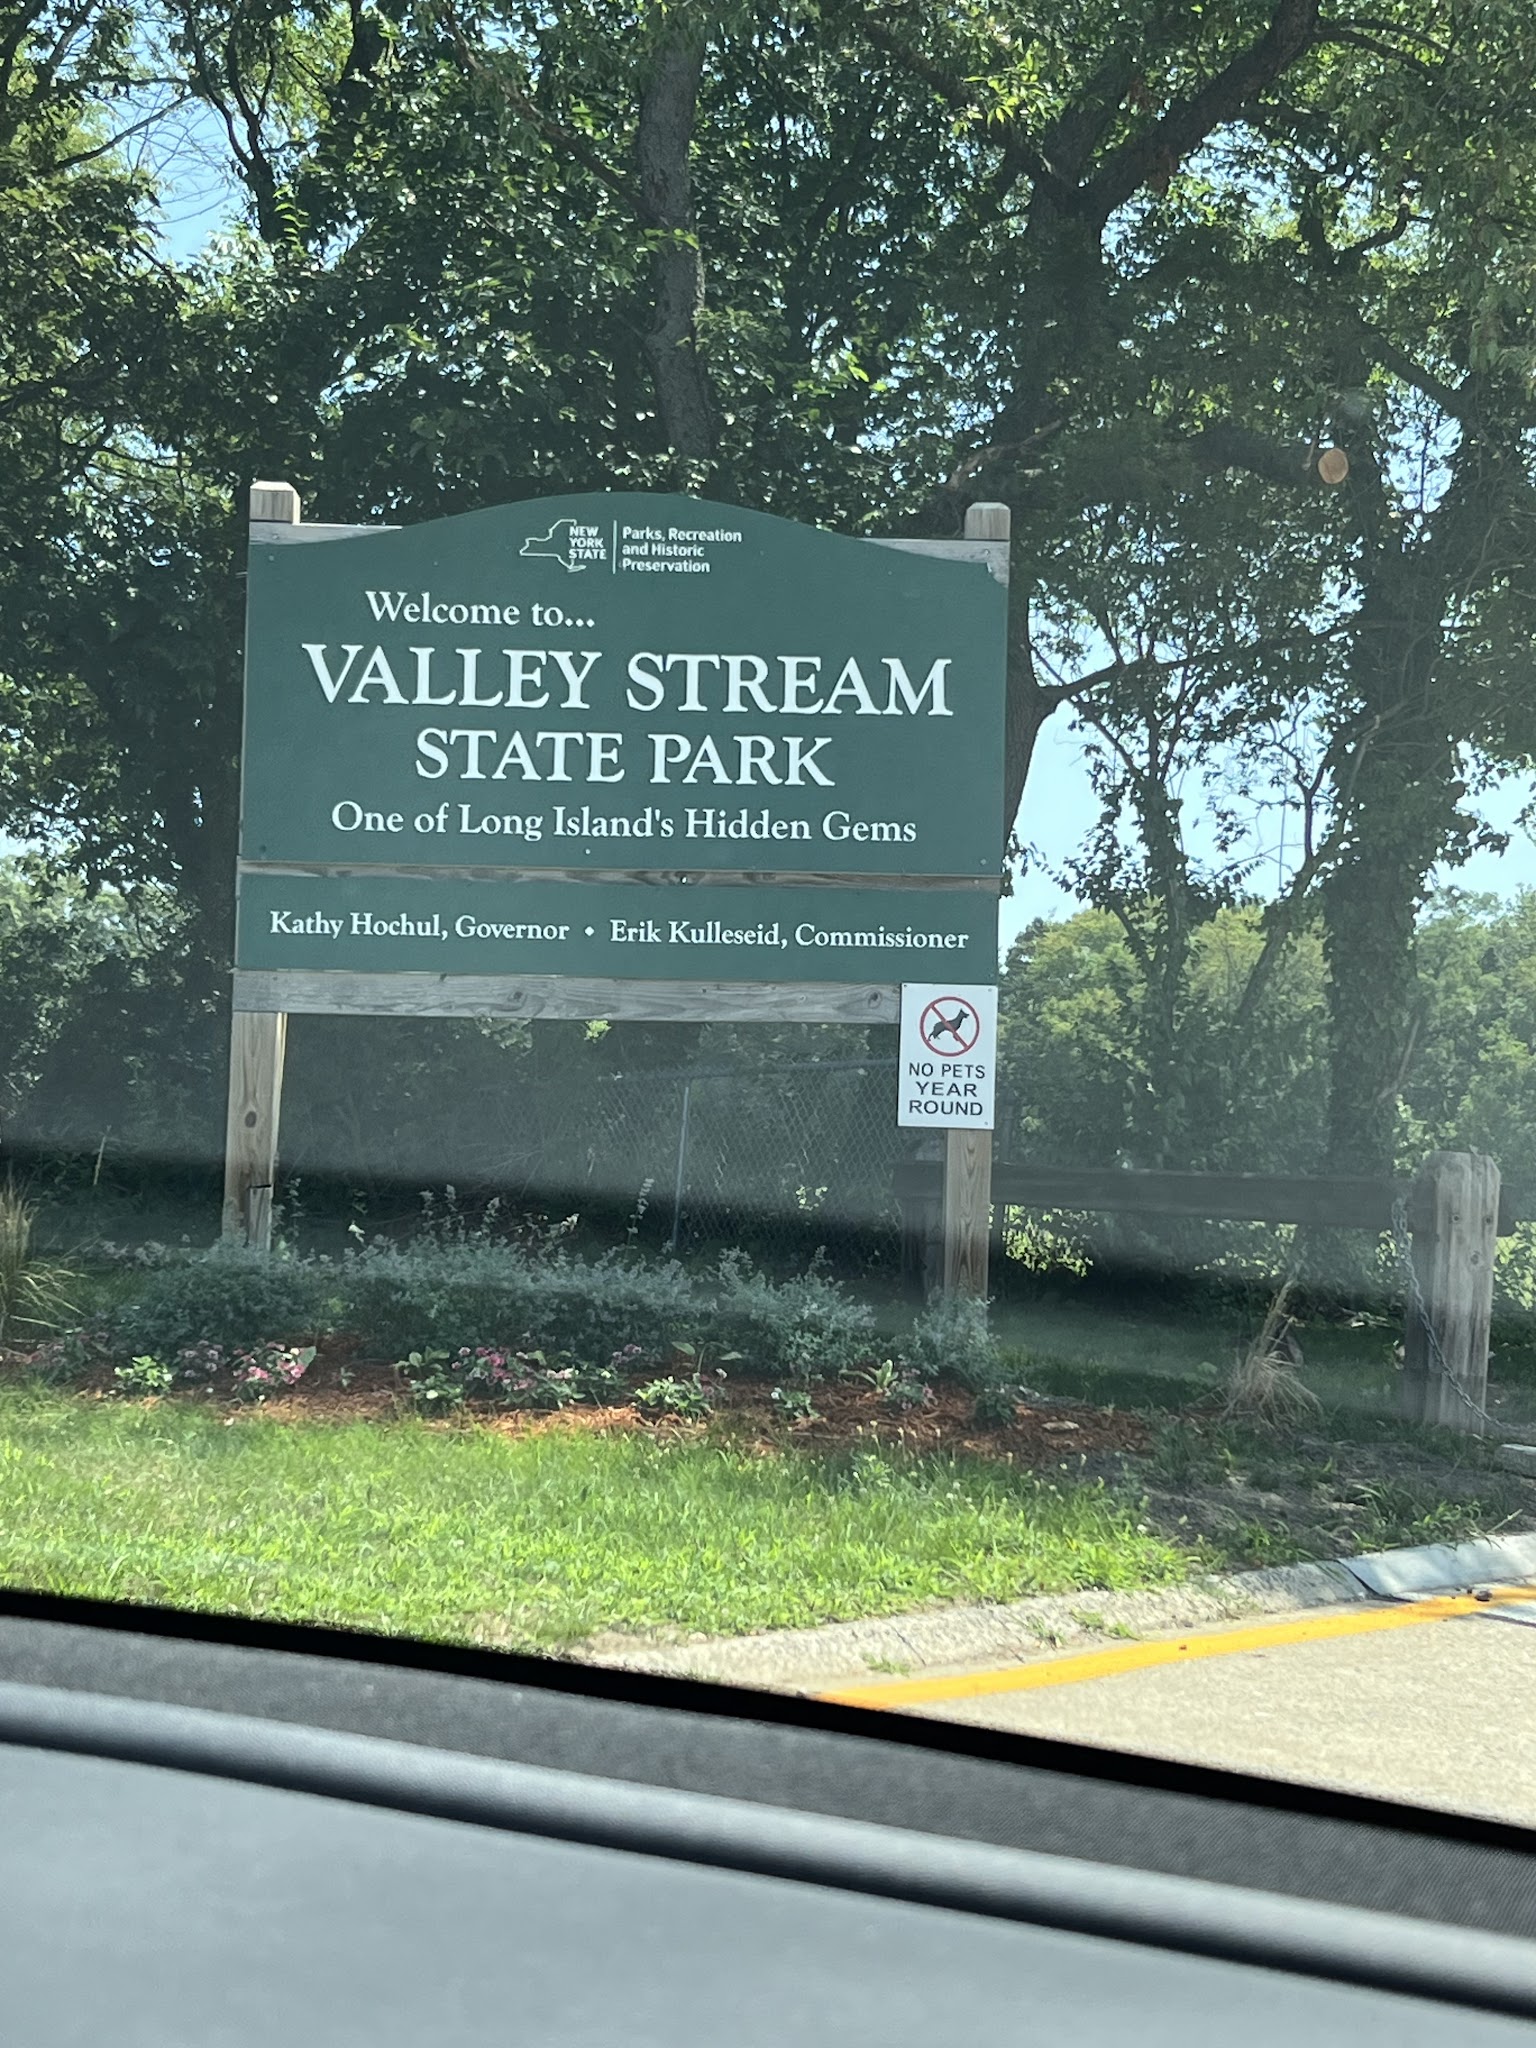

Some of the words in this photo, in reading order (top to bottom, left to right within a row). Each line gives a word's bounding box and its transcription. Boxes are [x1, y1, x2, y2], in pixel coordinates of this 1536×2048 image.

[569, 526, 599, 537] NEW
[622, 526, 666, 542] Parks,
[668, 528, 742, 543] Recreation
[569, 537, 604, 549] YORK
[622, 542, 649, 556] and
[651, 543, 705, 557] Historic
[568, 549, 607, 560] STATE
[622, 558, 711, 573] Preservation
[365, 590, 521, 625] Welcome
[531, 602, 595, 628] to...
[302, 643, 603, 710] VALLEY
[626, 651, 954, 717] STREAM
[415, 727, 625, 783] STATE
[647, 733, 836, 787] PARK
[331, 800, 404, 833] One
[413, 801, 450, 833] of
[457, 803, 544, 842] Long
[552, 805, 675, 838] Island's
[684, 808, 813, 840] Hidden
[822, 810, 918, 842] Gems
[269, 910, 344, 940] Kathy
[349, 912, 449, 941] Hochul,
[454, 914, 571, 940] Governor
[609, 919, 662, 943] Erik
[668, 920, 788, 950] Kulleseid,
[794, 923, 970, 949] Commissioner
[908, 1062, 934, 1077] NO
[941, 1063, 986, 1079] PETS
[915, 1081, 978, 1098] YEAR
[908, 1100, 983, 1116] ROUND
